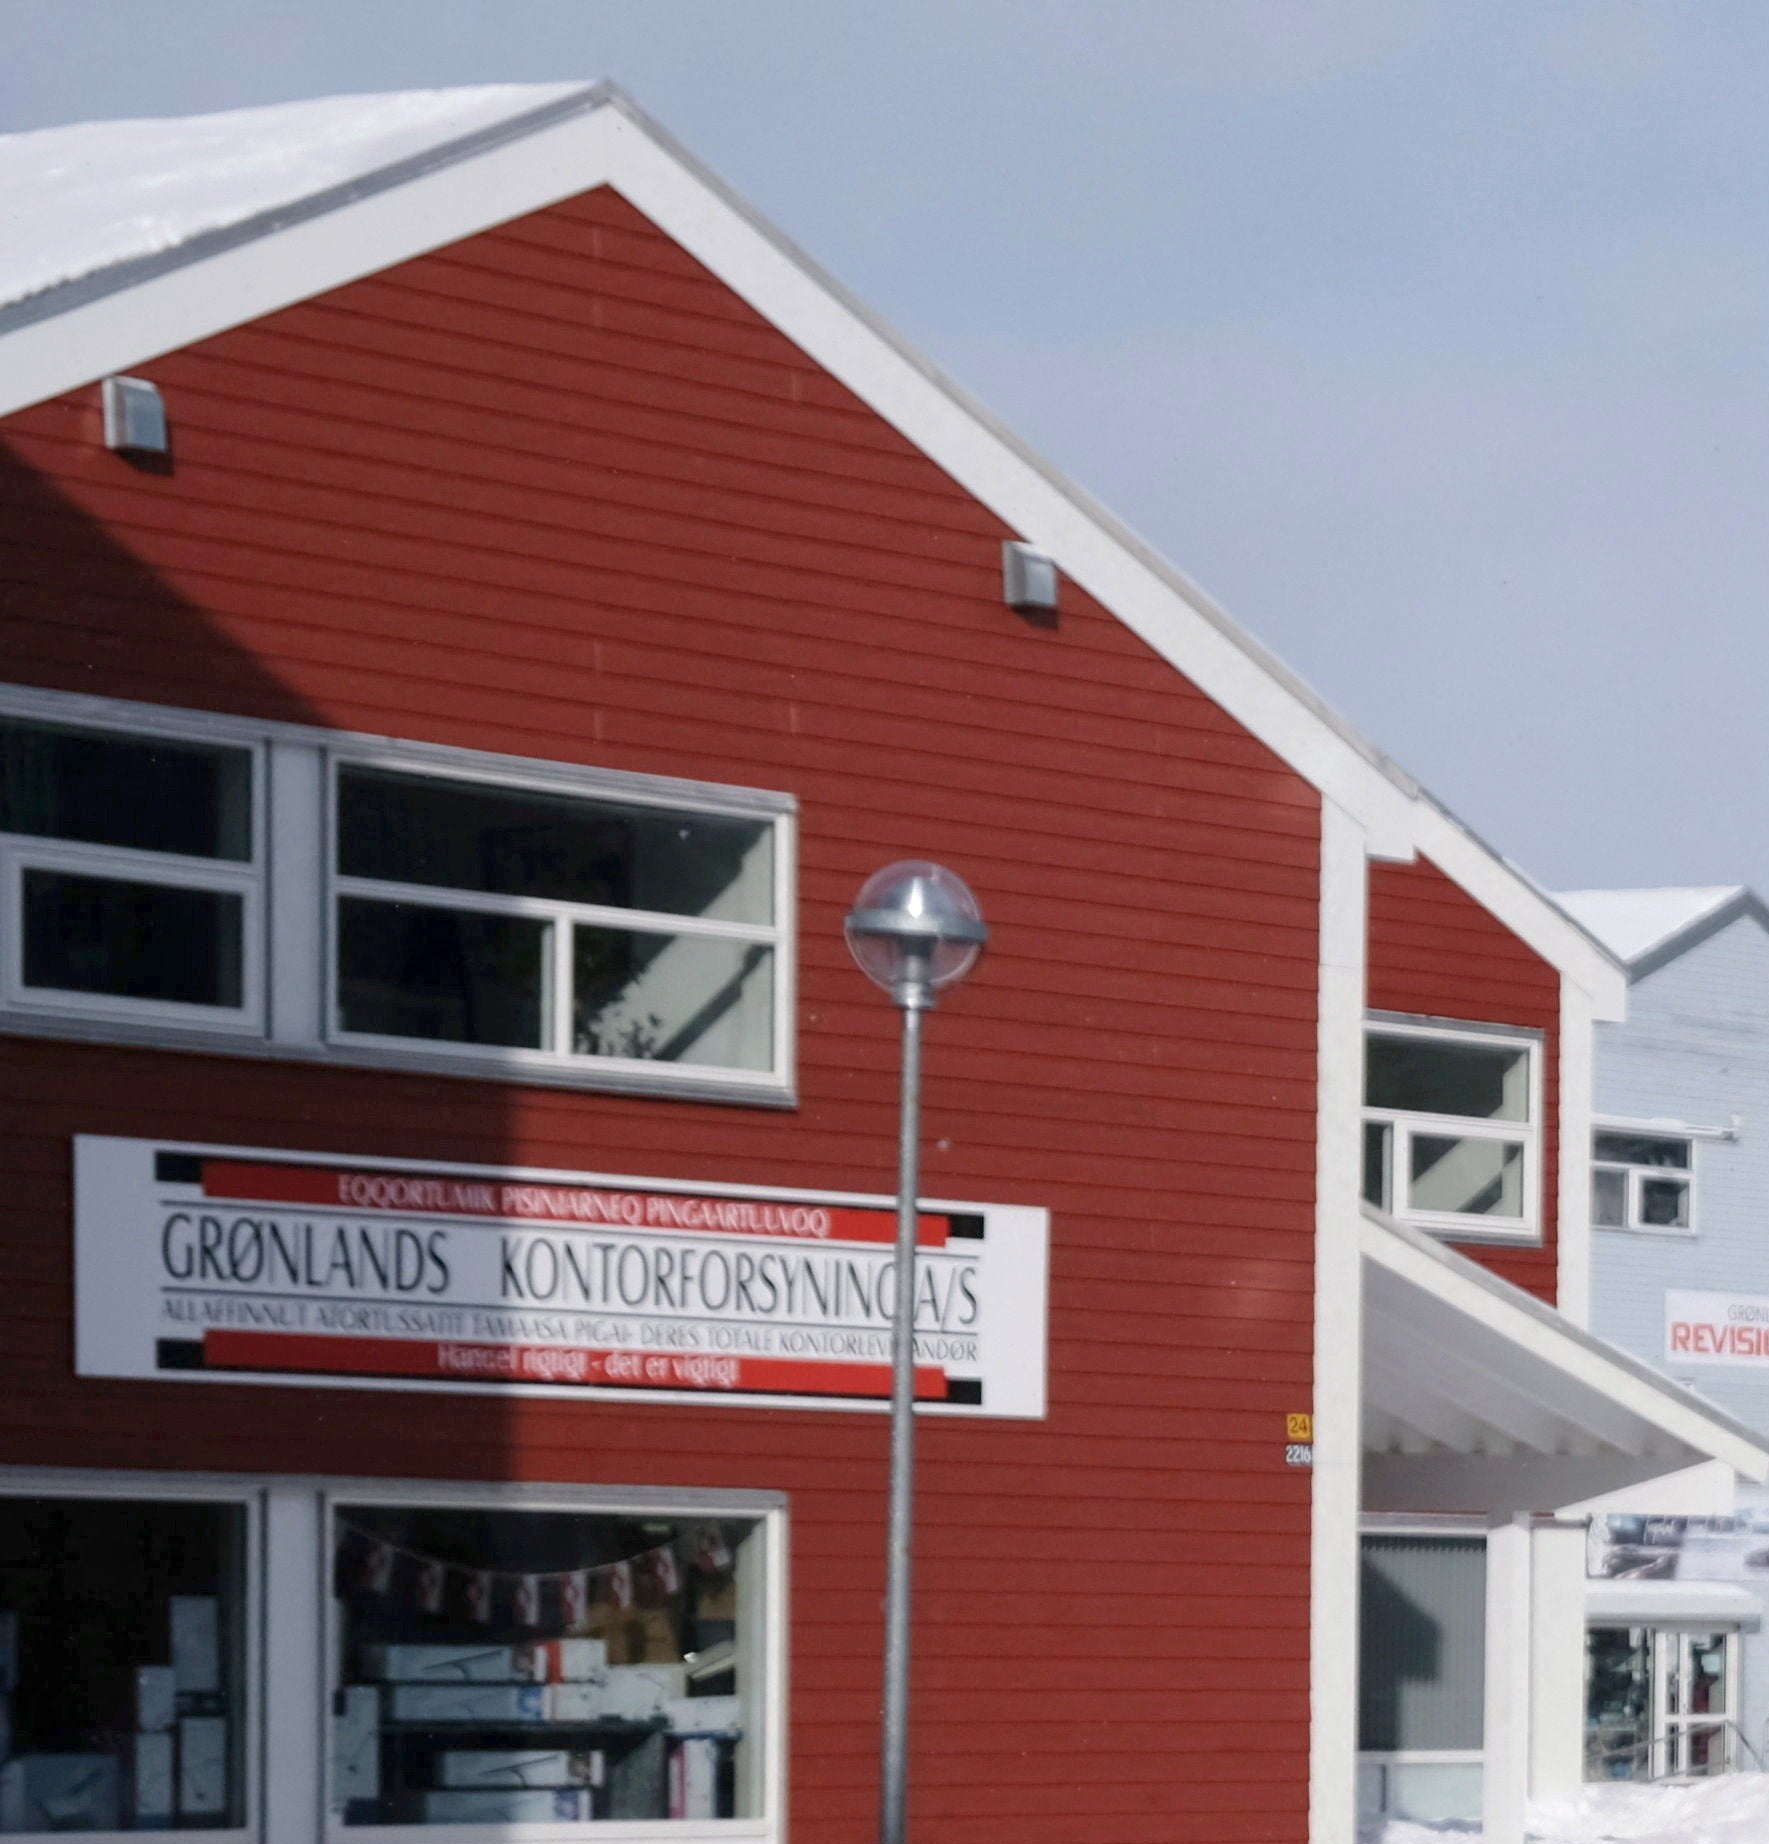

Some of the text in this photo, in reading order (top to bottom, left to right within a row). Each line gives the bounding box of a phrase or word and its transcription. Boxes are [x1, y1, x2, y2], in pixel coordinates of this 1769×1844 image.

[162, 1213, 450, 1294] GRØNLANDS
[640, 1322, 699, 1347] DERES
[706, 1326, 774, 1352] TOTALE
[779, 1330, 978, 1363] KONTORLEVANDØR
[604, 1352, 642, 1378] det
[645, 1356, 671, 1380] er
[1289, 1415, 1308, 1435] 24
